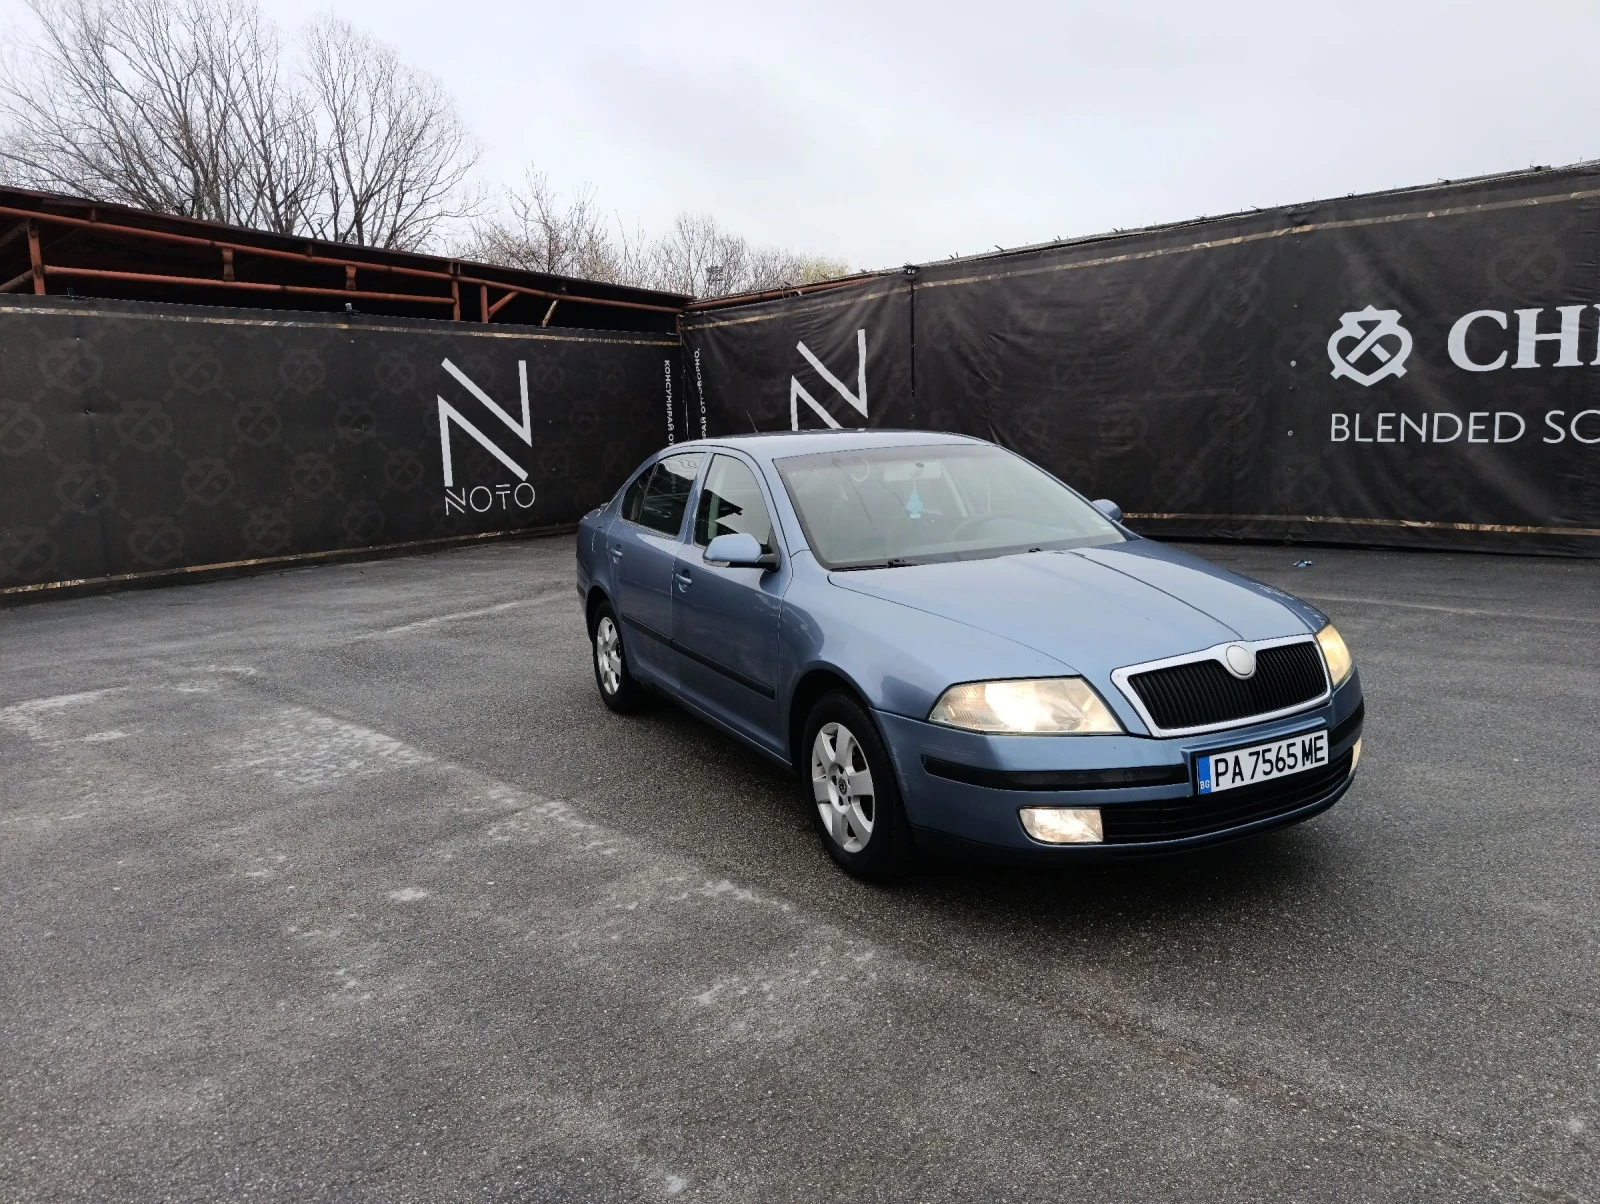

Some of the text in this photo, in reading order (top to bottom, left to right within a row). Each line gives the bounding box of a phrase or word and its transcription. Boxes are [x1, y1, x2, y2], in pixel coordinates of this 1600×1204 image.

[664, 360, 675, 431] КОНСУМИРАЙ
[437, 357, 533, 487] N
[1330, 412, 1526, 443] BLENDED
[445, 482, 536, 516] NOTO
[1214, 734, 1326, 788] PA 7565 ME
[1199, 780, 1211, 790] BG
